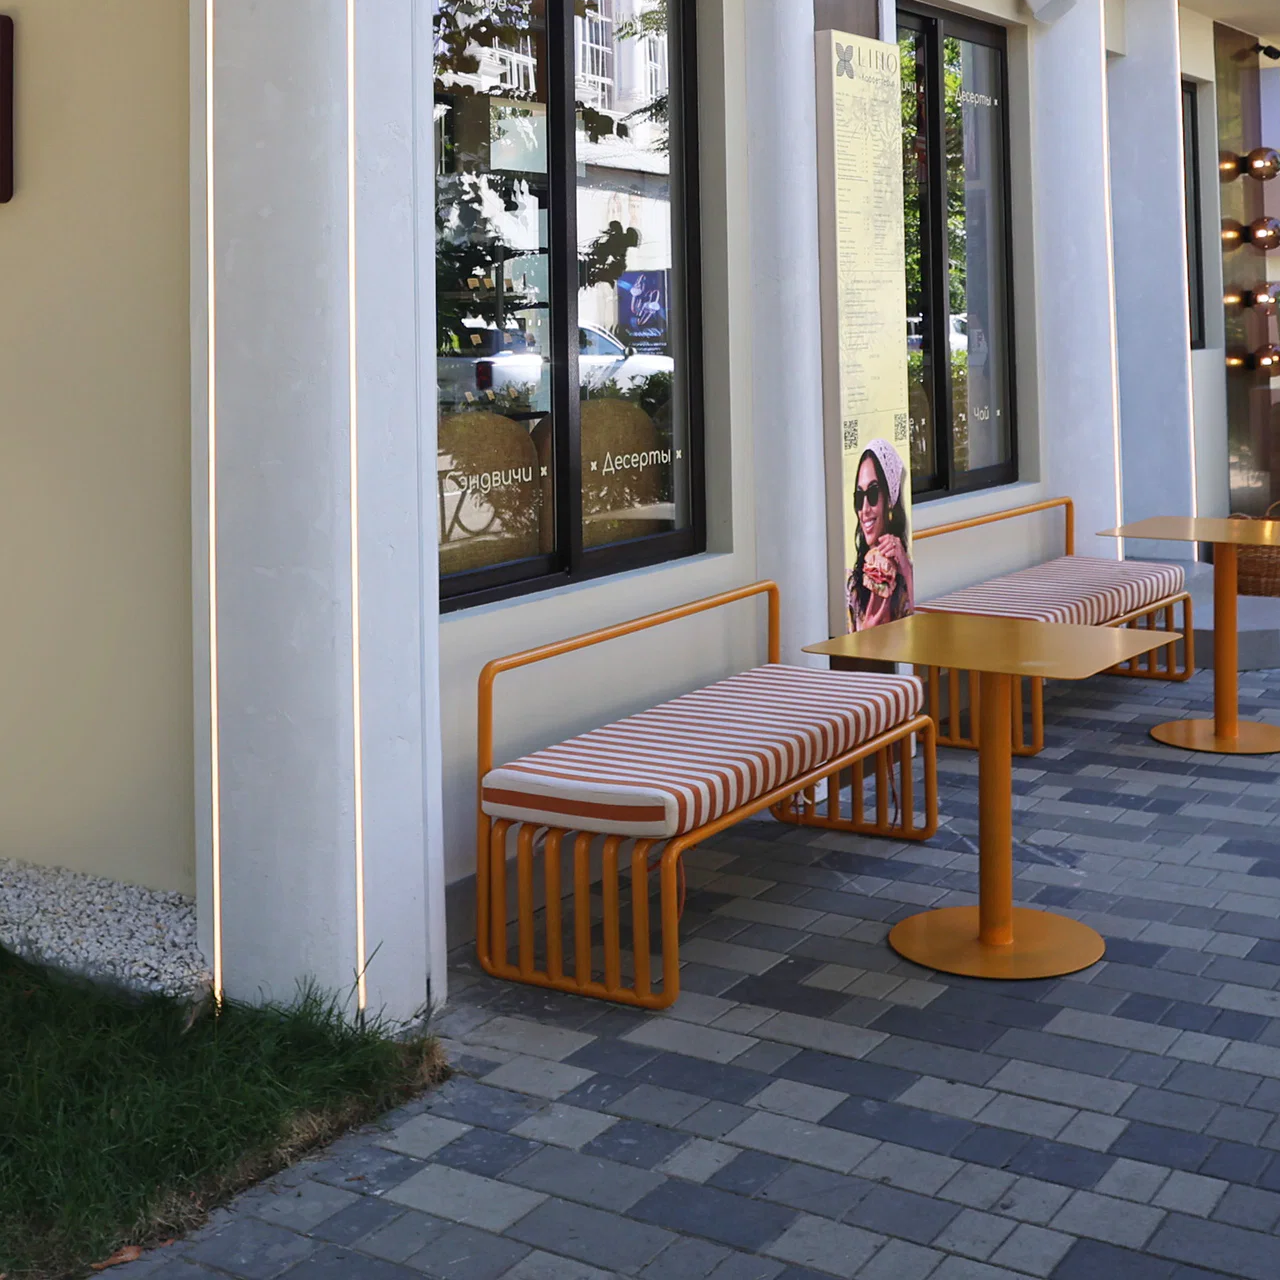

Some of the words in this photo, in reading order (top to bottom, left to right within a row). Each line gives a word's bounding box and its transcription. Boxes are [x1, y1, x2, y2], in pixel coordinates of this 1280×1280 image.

[858, 46, 898, 76] LINO
[955, 86, 992, 107] Десерты
[602, 448, 671, 476] Десерты
[445, 466, 533, 494] Сэндвичи
